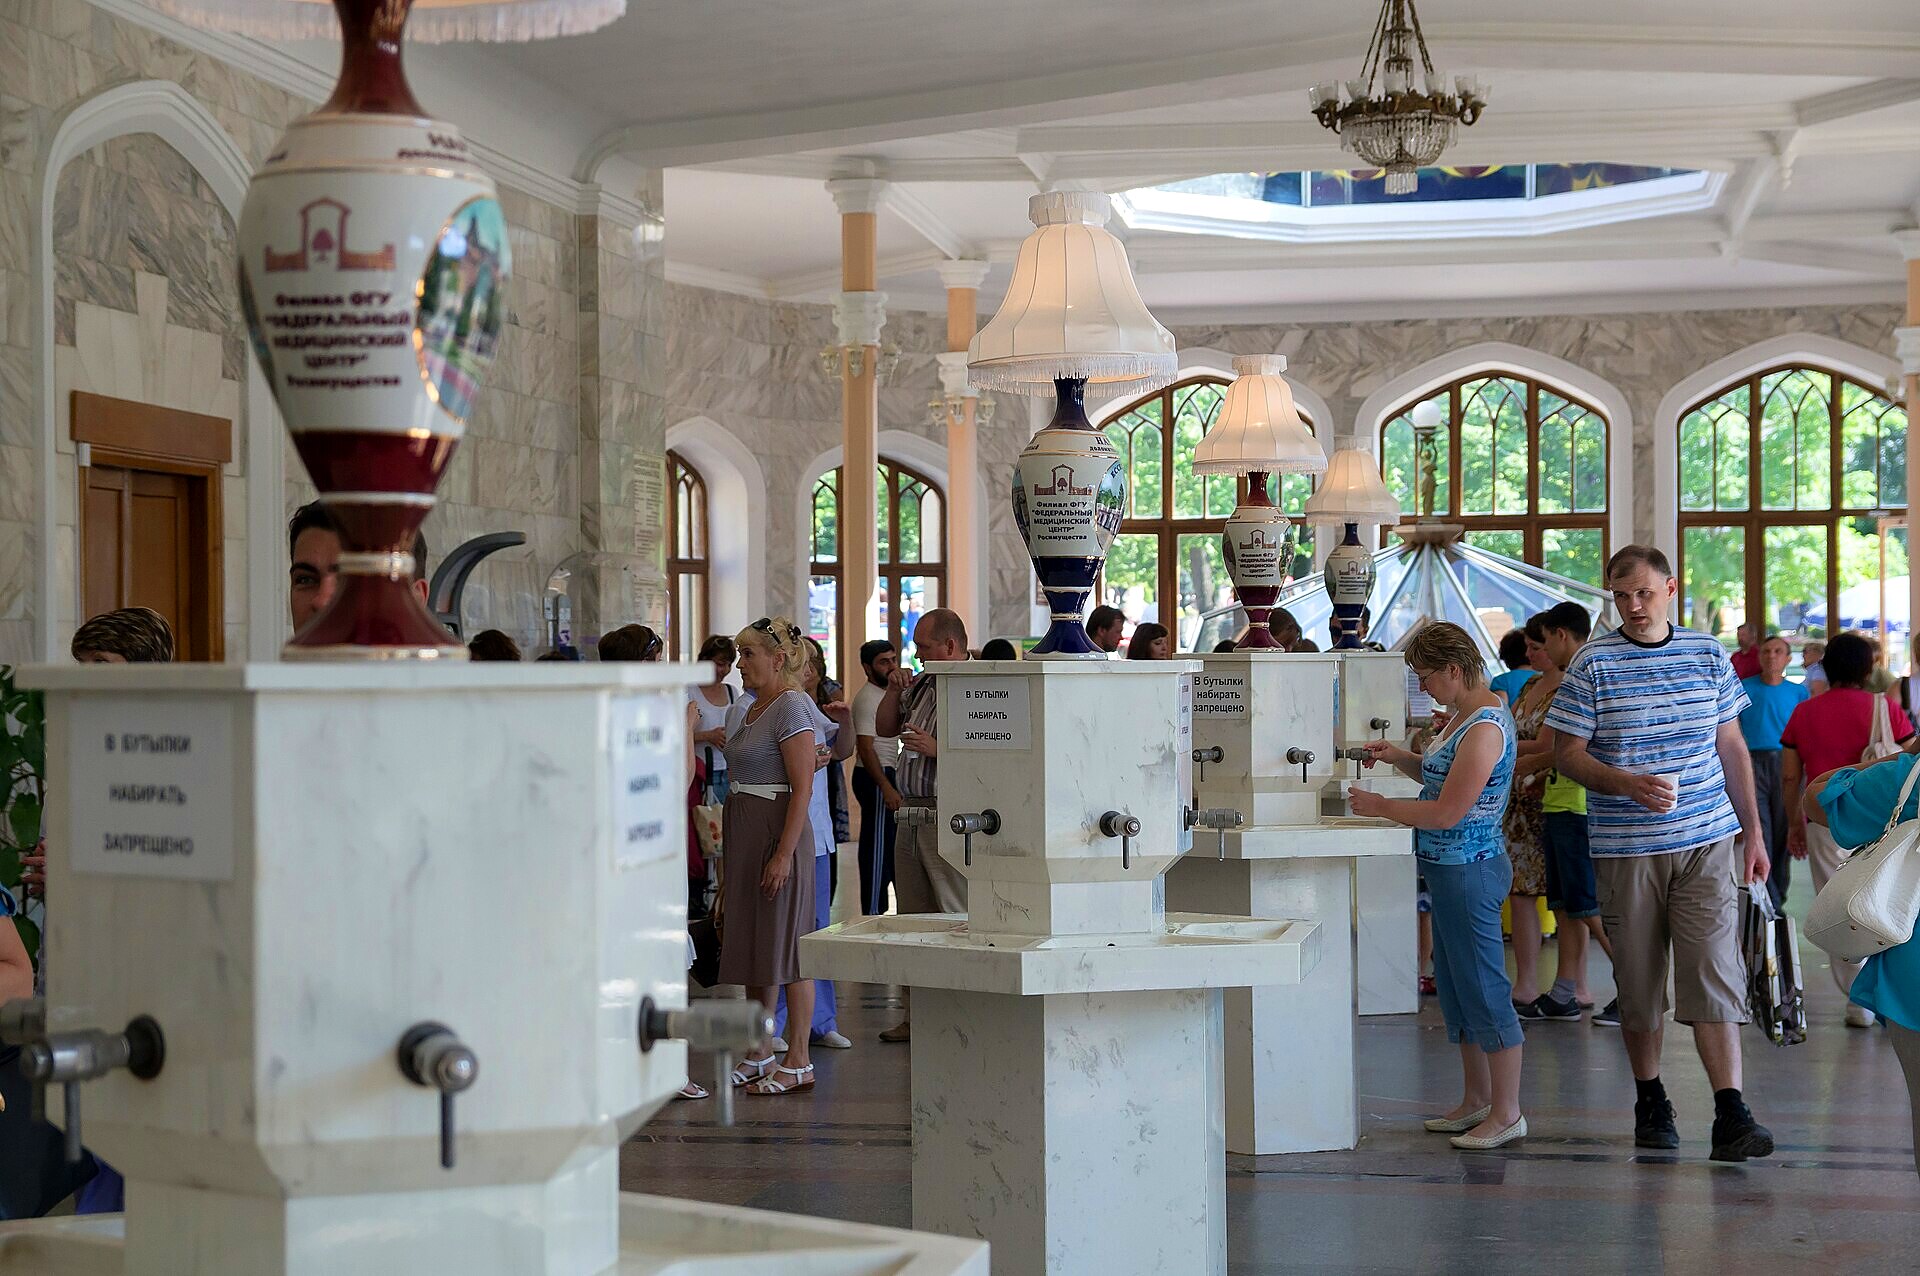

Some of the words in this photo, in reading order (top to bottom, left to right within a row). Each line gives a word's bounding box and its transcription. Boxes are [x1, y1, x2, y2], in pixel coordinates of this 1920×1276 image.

[1032, 509, 1093, 517] "ФЕДЕРАЛЬНЫЙ
[1033, 517, 1090, 525] МЕДИЦИНСКИЙ
[1194, 677, 1201, 685] В
[1203, 677, 1243, 687] бутылки
[965, 691, 971, 699] В
[974, 691, 1009, 699] БУТЫЛКИ
[1196, 690, 1241, 700] набирать
[1193, 704, 1245, 714] запрещено
[968, 711, 1008, 720] НАБИРАТЬ
[965, 731, 1012, 741] ЗАПРЕЩЕНО
[109, 784, 187, 805] НАБИРАТЬ
[103, 832, 194, 856] ЗАПРЕЩЕНО
